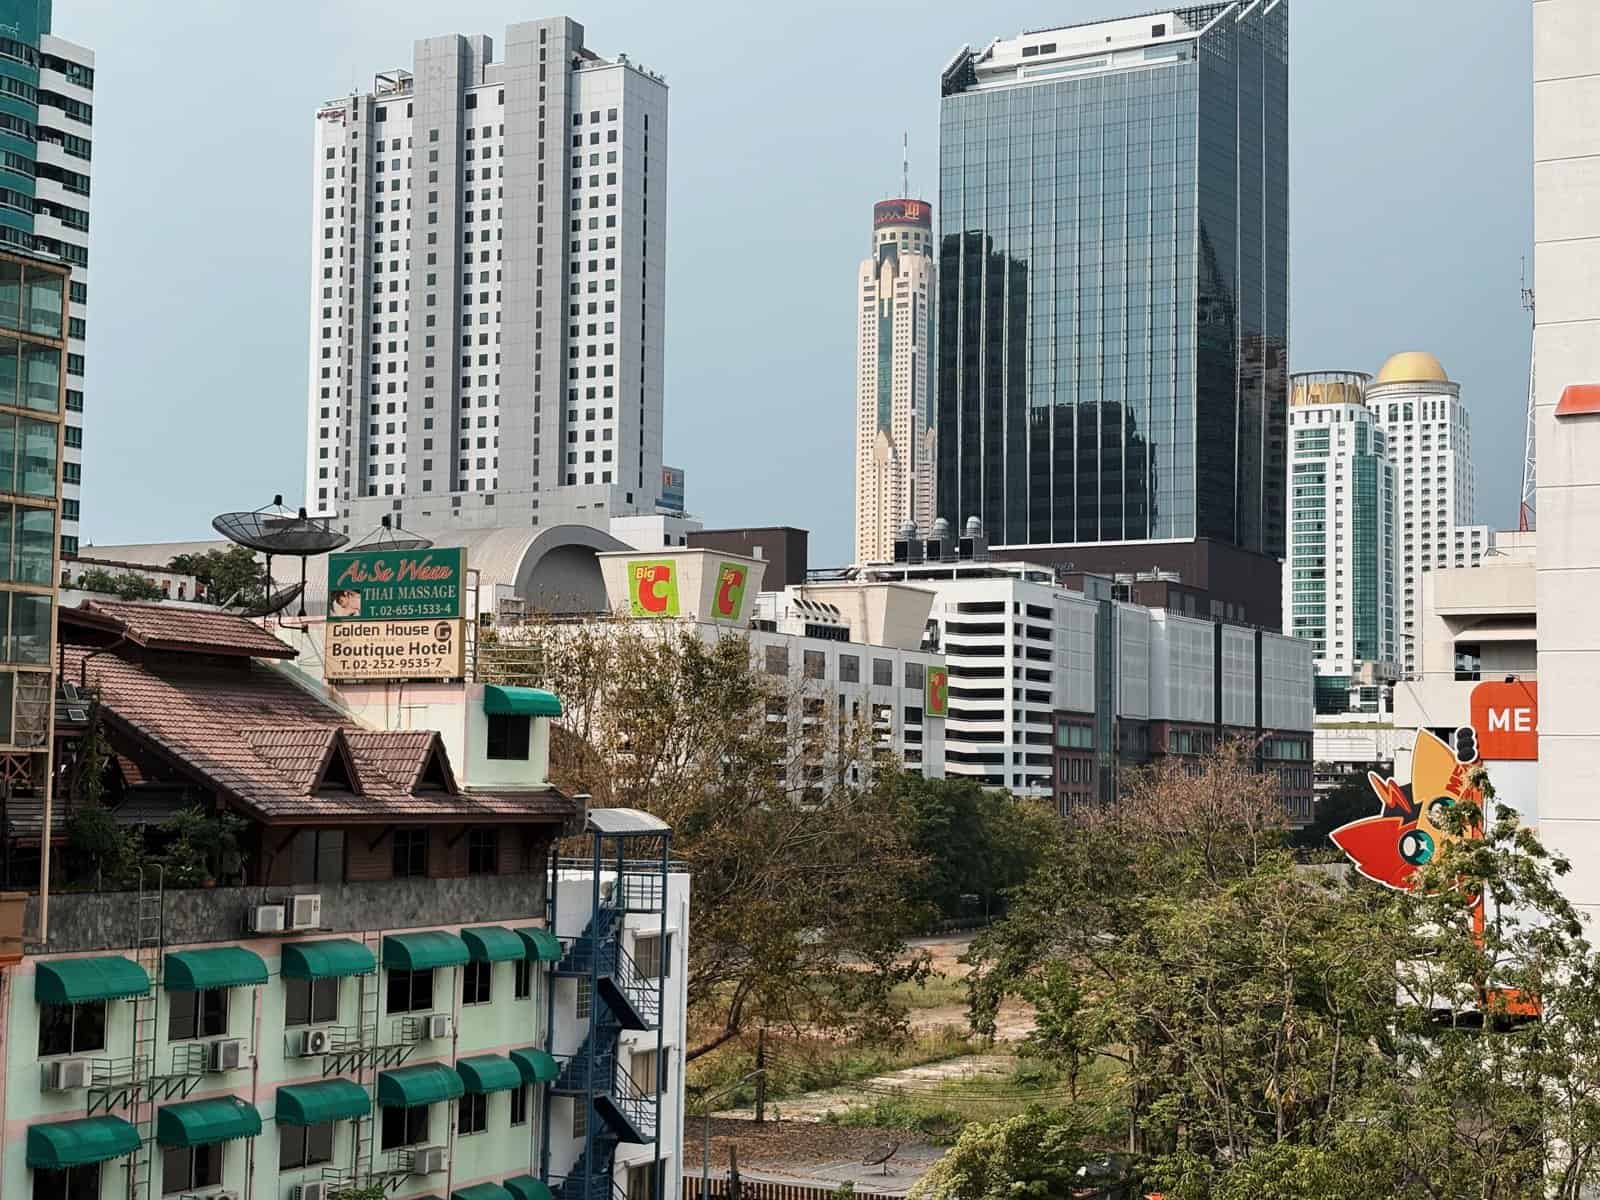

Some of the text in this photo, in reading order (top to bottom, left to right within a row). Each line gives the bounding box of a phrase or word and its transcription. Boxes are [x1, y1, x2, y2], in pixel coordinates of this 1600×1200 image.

[636, 567, 656, 582] Big
[363, 585, 457, 600] THAI MASSAGE
[638, 565, 671, 613] C
[718, 570, 744, 615] C
[333, 624, 380, 637] Golden
[385, 623, 430, 636] House
[332, 640, 452, 659] Boutique Hotel
[352, 658, 442, 670] 02-252-9535-7
[1488, 707, 1538, 732] ME
